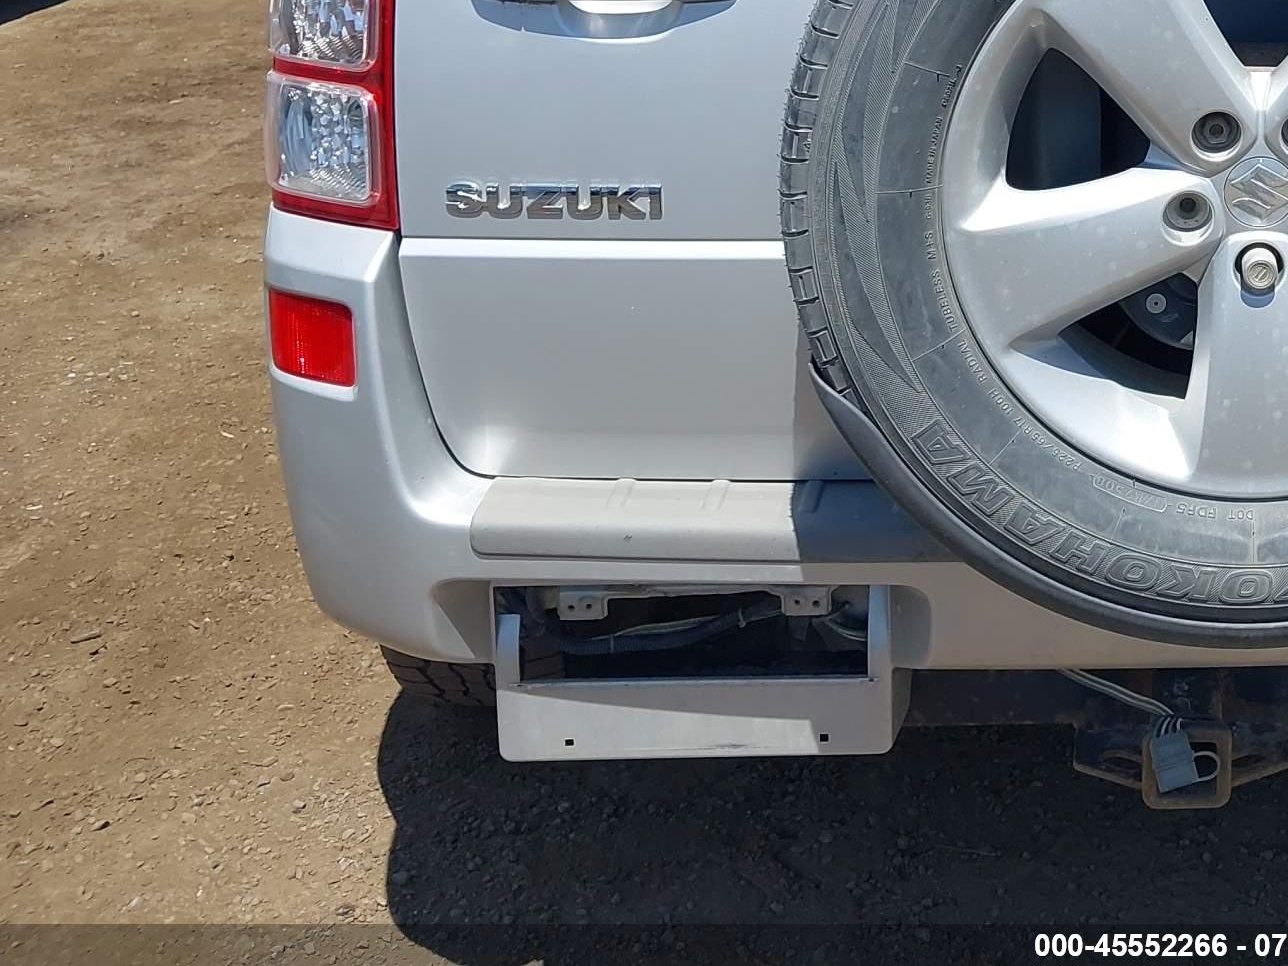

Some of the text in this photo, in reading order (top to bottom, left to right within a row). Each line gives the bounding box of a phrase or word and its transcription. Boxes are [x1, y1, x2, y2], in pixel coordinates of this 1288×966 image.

[446, 181, 663, 220] SUZUKI
[931, 268, 958, 332] TUBELESS
[957, 338, 988, 386] RADIAL
[1227, 508, 1254, 521] DOT
